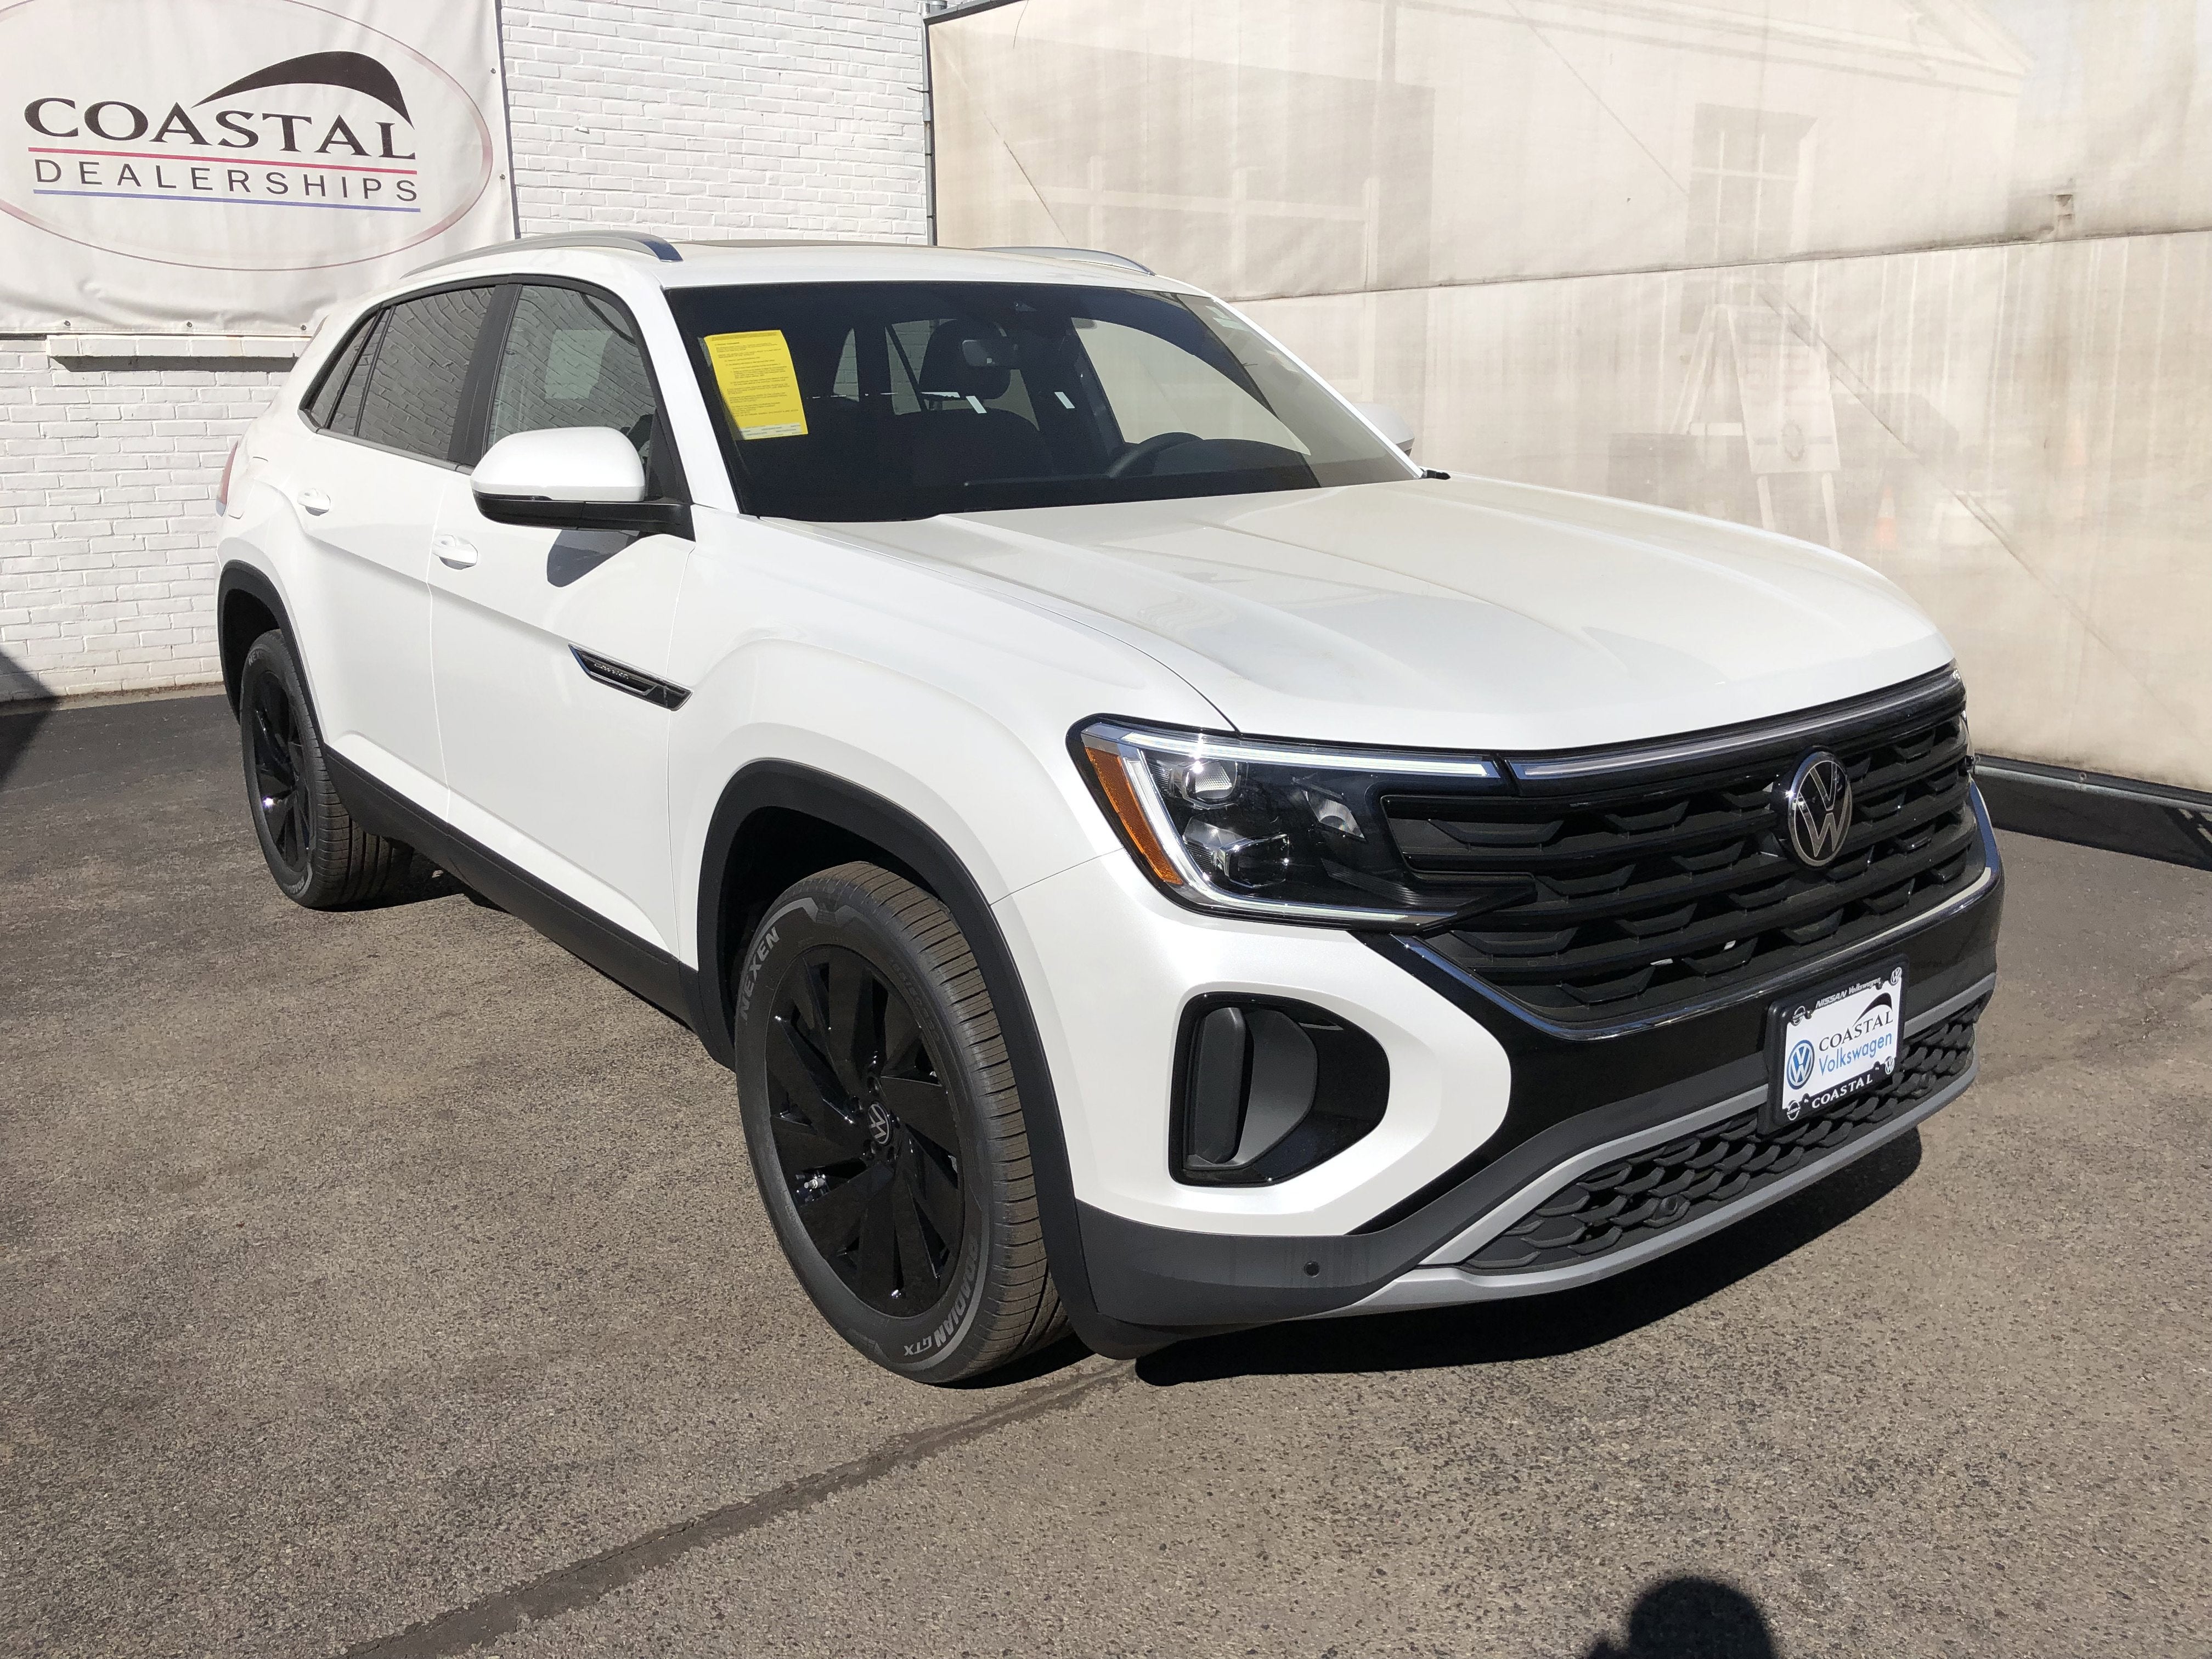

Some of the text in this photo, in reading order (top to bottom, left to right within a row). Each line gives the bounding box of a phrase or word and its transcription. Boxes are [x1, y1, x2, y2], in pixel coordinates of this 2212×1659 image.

[24, 98, 416, 160] COASTAL
[36, 159, 417, 202] DEALERSHIPS
[740, 926, 780, 1021] NEXEN
[1815, 990, 1847, 1008] NISSAN
[1819, 1011, 1893, 1051] COASTAL
[1819, 1033, 1892, 1076] Volkswagen
[1812, 1074, 1873, 1108] COASTAL
[904, 1335, 932, 1356] GTX
